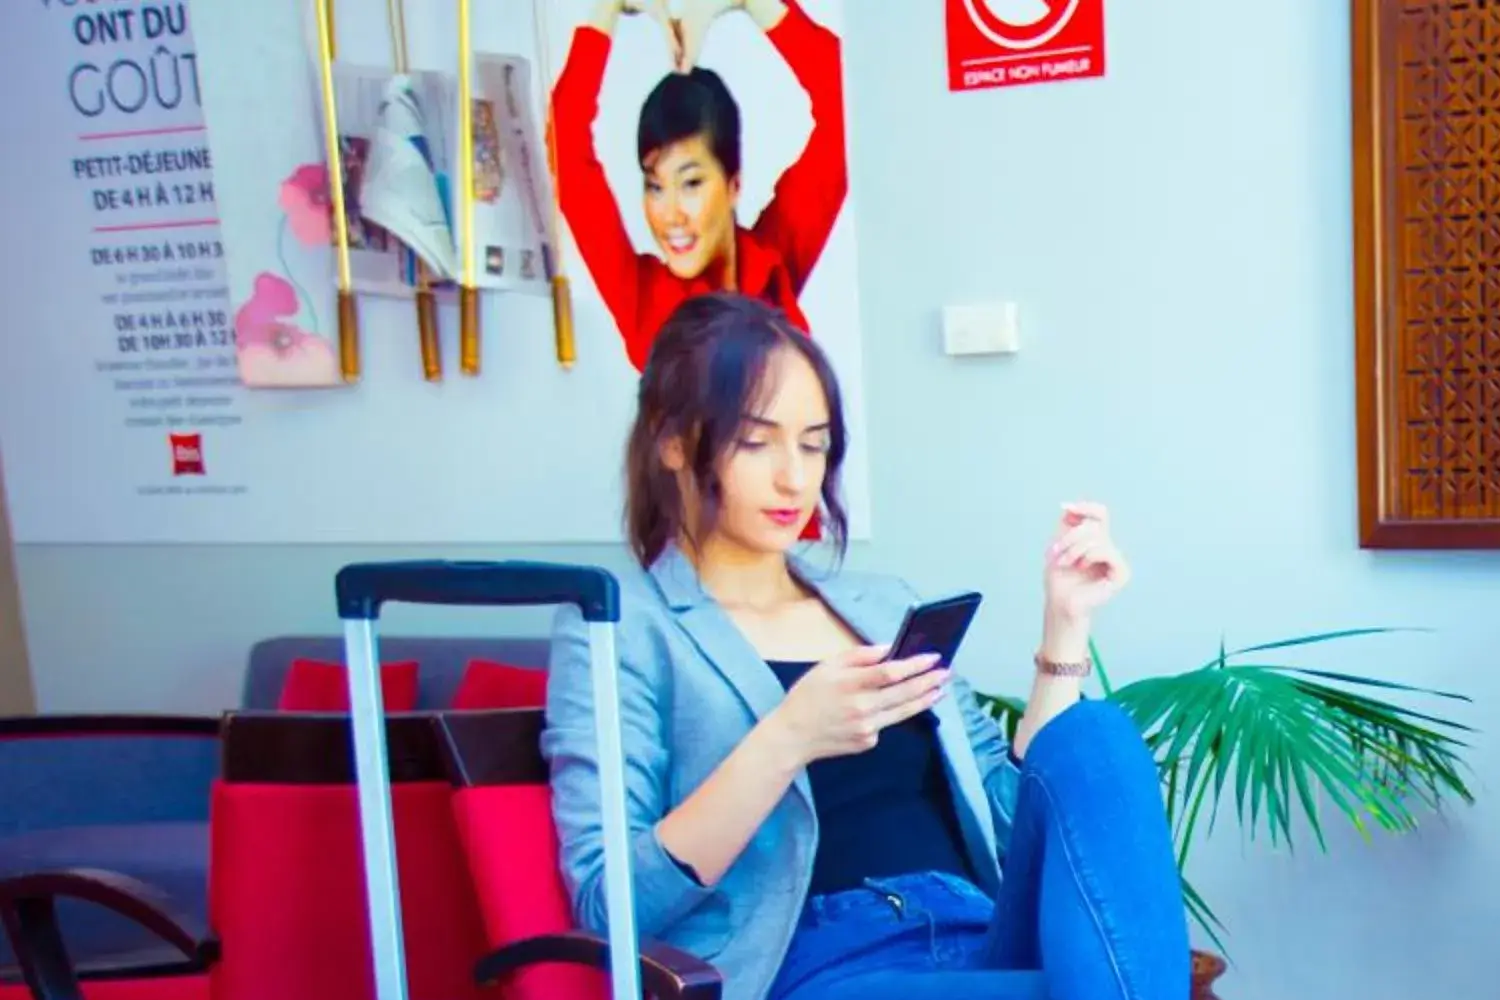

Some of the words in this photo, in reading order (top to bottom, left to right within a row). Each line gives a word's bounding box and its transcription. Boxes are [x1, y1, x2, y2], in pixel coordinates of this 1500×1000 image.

[73, 9, 135, 46] ONT
[142, 2, 188, 39] DU
[92, 187, 119, 211] DE
[121, 188, 134, 208] 4
[136, 185, 151, 207] H
[155, 180, 170, 207] À
[172, 183, 196, 205] 12
[198, 180, 216, 203] H
[92, 246, 114, 267] DE
